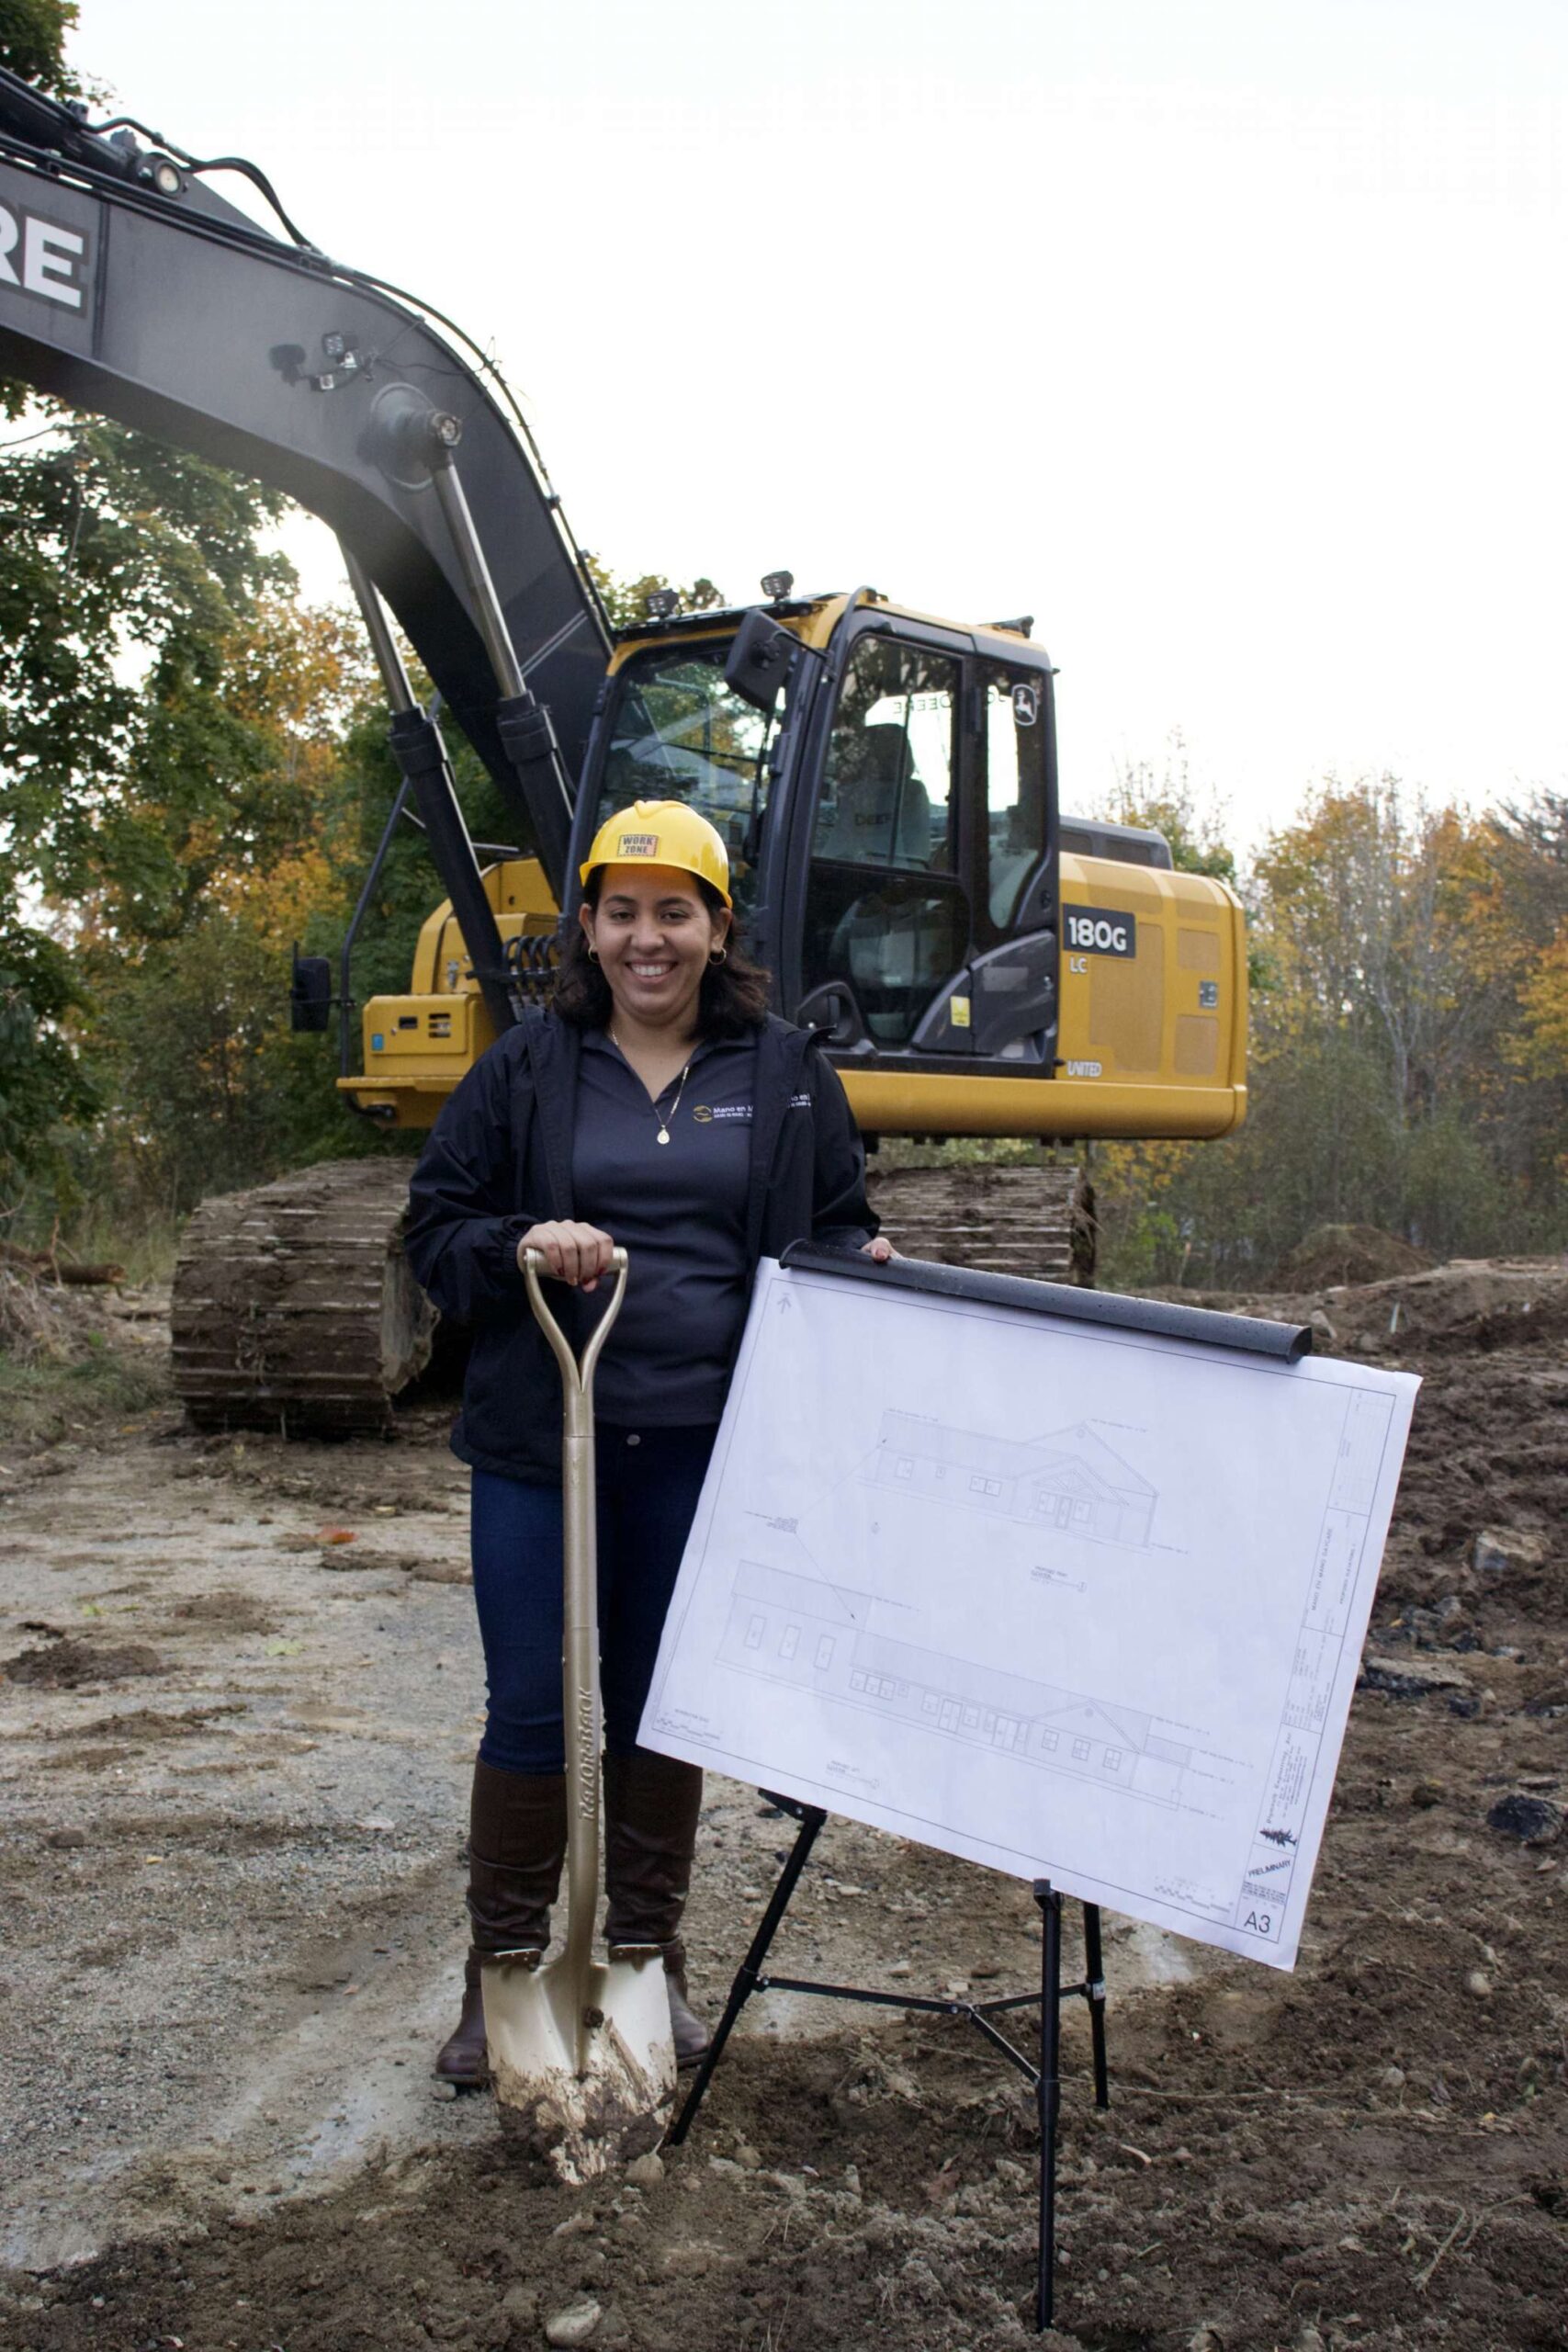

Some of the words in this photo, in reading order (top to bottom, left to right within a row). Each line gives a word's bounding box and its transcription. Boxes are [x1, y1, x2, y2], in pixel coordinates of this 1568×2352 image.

[623, 836, 654, 845] WORK
[625, 845, 648, 854] ZONE
[1068, 916, 1127, 952] 180G
[1070, 956, 1088, 974] LC
[1066, 1060, 1102, 1078] UNITED
[578, 1687, 596, 1821] RAZOR-BACK
[1247, 1859, 1292, 1879] PRELIMINARY
[1244, 1911, 1271, 1934] A3
